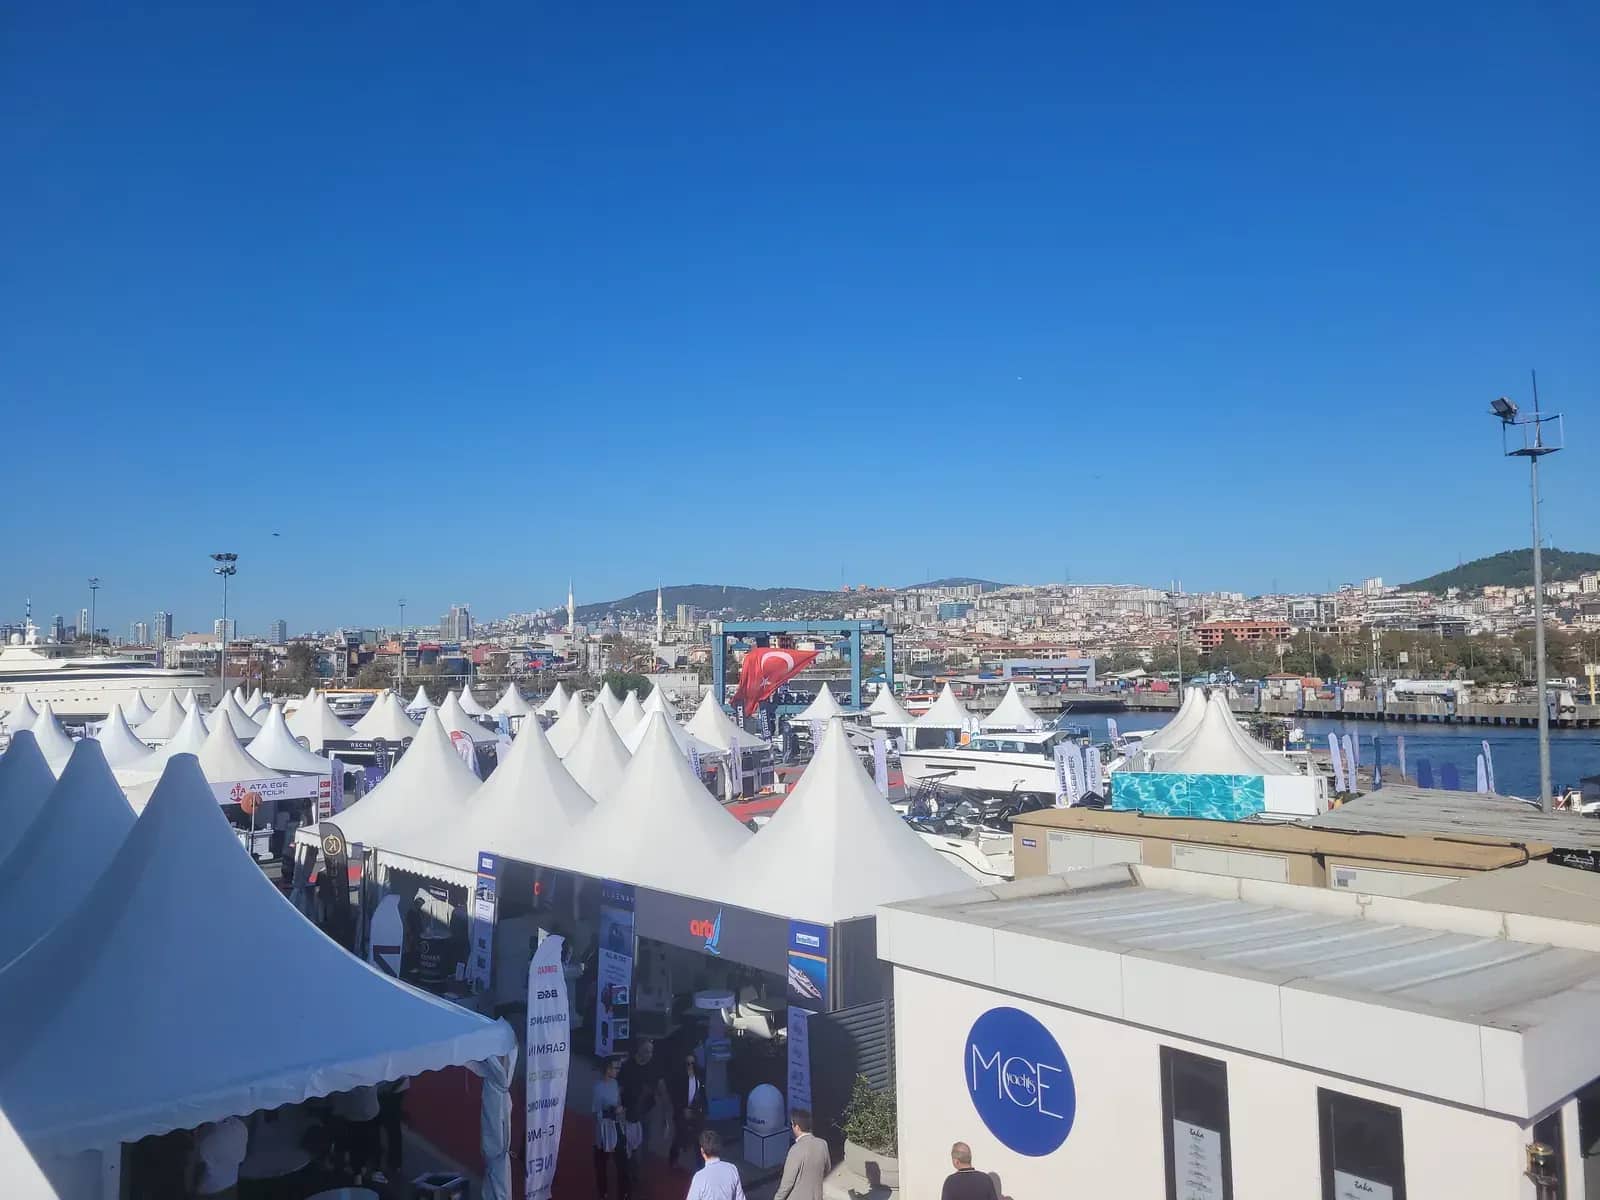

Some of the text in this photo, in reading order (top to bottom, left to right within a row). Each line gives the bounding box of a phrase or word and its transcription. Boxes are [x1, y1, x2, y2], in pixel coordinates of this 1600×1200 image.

[249, 782, 267, 790] ATA
[230, 787, 246, 795] ATA
[972, 1043, 1064, 1119] MCE
